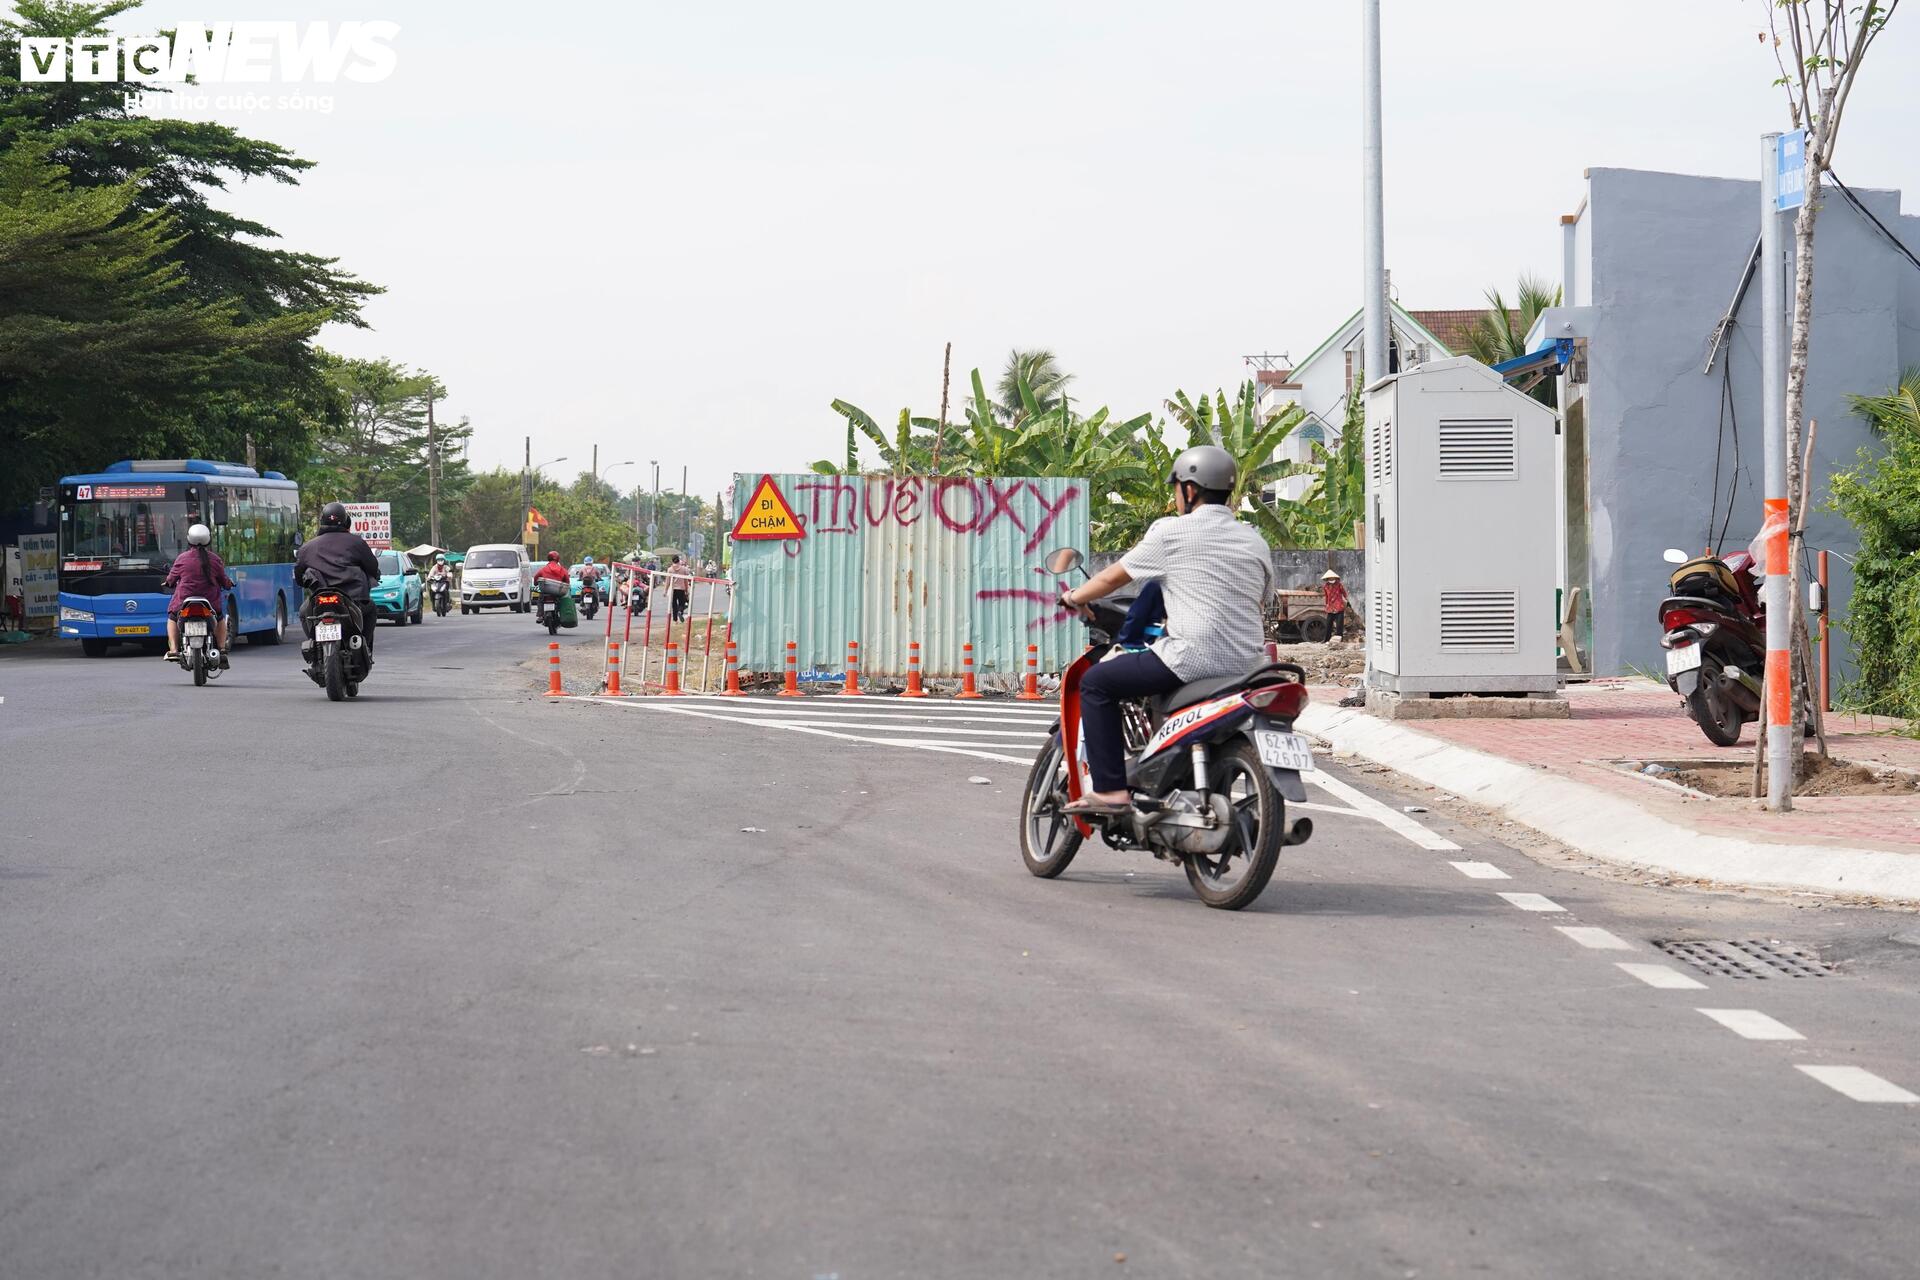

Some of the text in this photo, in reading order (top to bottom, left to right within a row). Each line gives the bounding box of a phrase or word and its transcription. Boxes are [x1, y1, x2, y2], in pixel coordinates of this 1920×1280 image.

[79, 488, 91, 498] 47
[761, 499, 773, 510] ĐI
[355, 519, 369, 532] VỎ
[751, 516, 786, 530] CHẬM
[1158, 708, 1204, 741] REPSOL
